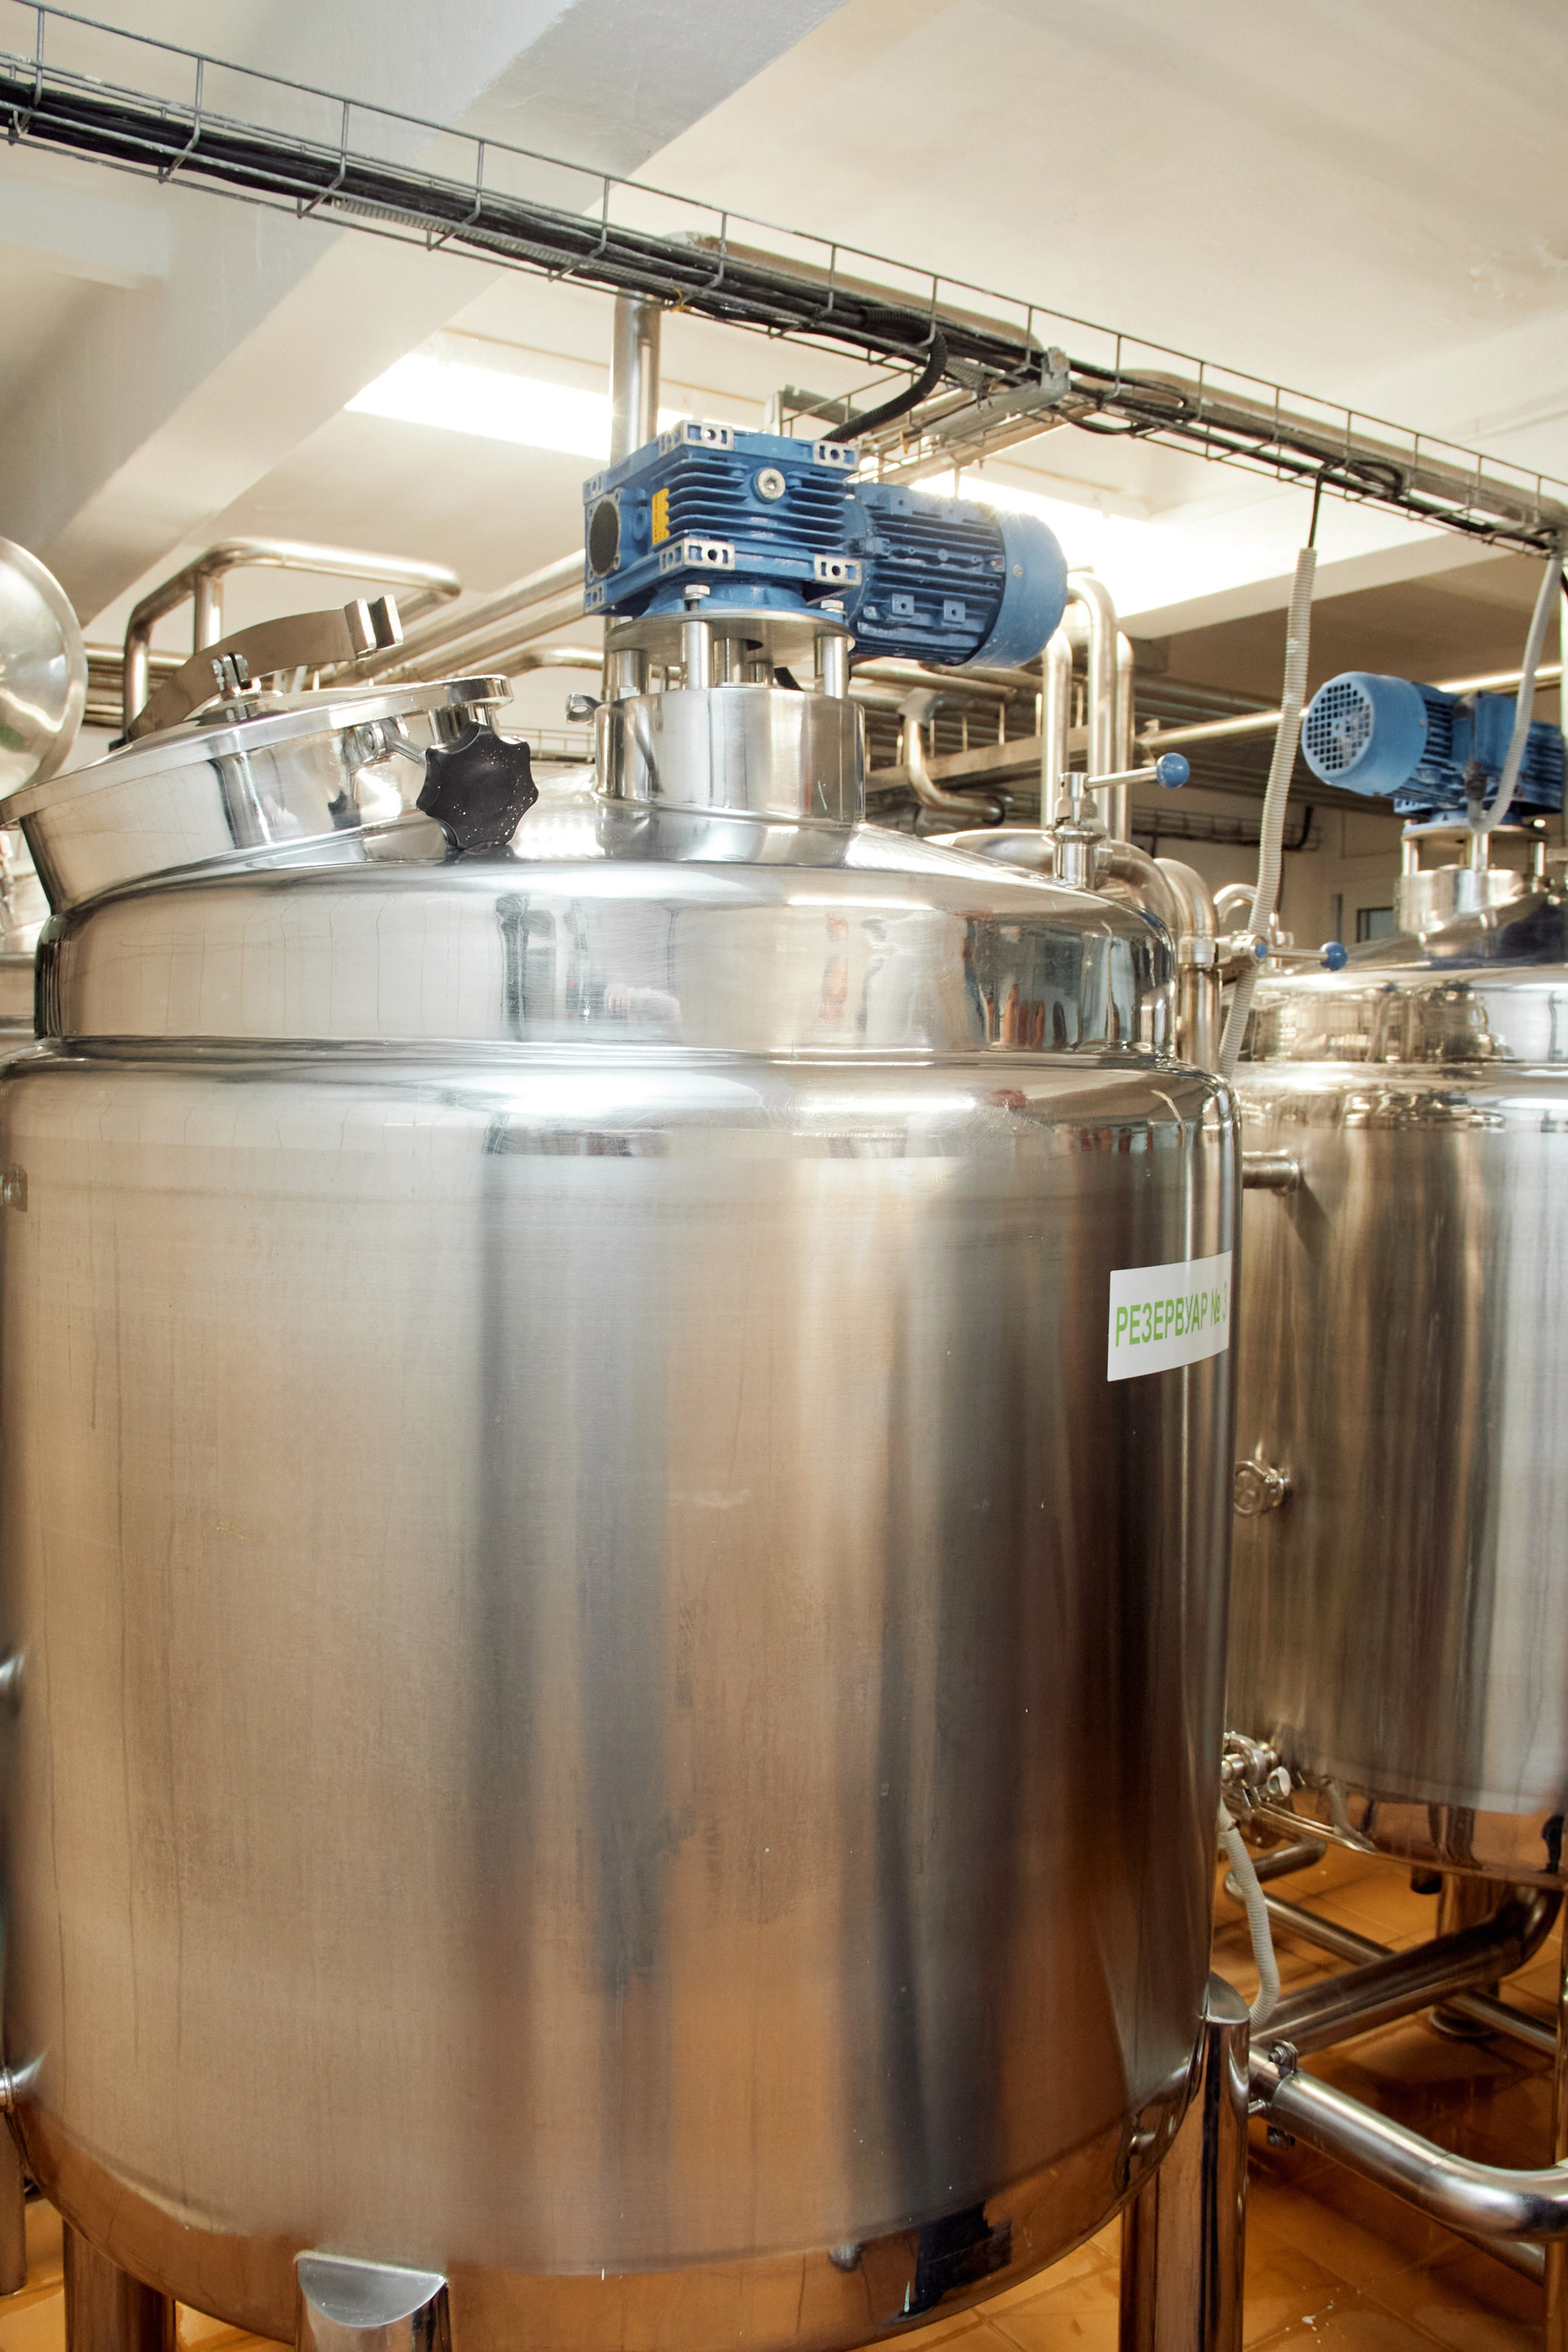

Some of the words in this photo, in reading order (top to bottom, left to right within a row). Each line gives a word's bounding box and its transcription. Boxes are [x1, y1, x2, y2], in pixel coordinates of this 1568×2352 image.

[1115, 1291, 1208, 1348] РЕЗЕРВУАР
[1210, 1287, 1221, 1325] №
[1222, 1281, 1227, 1321] 3
